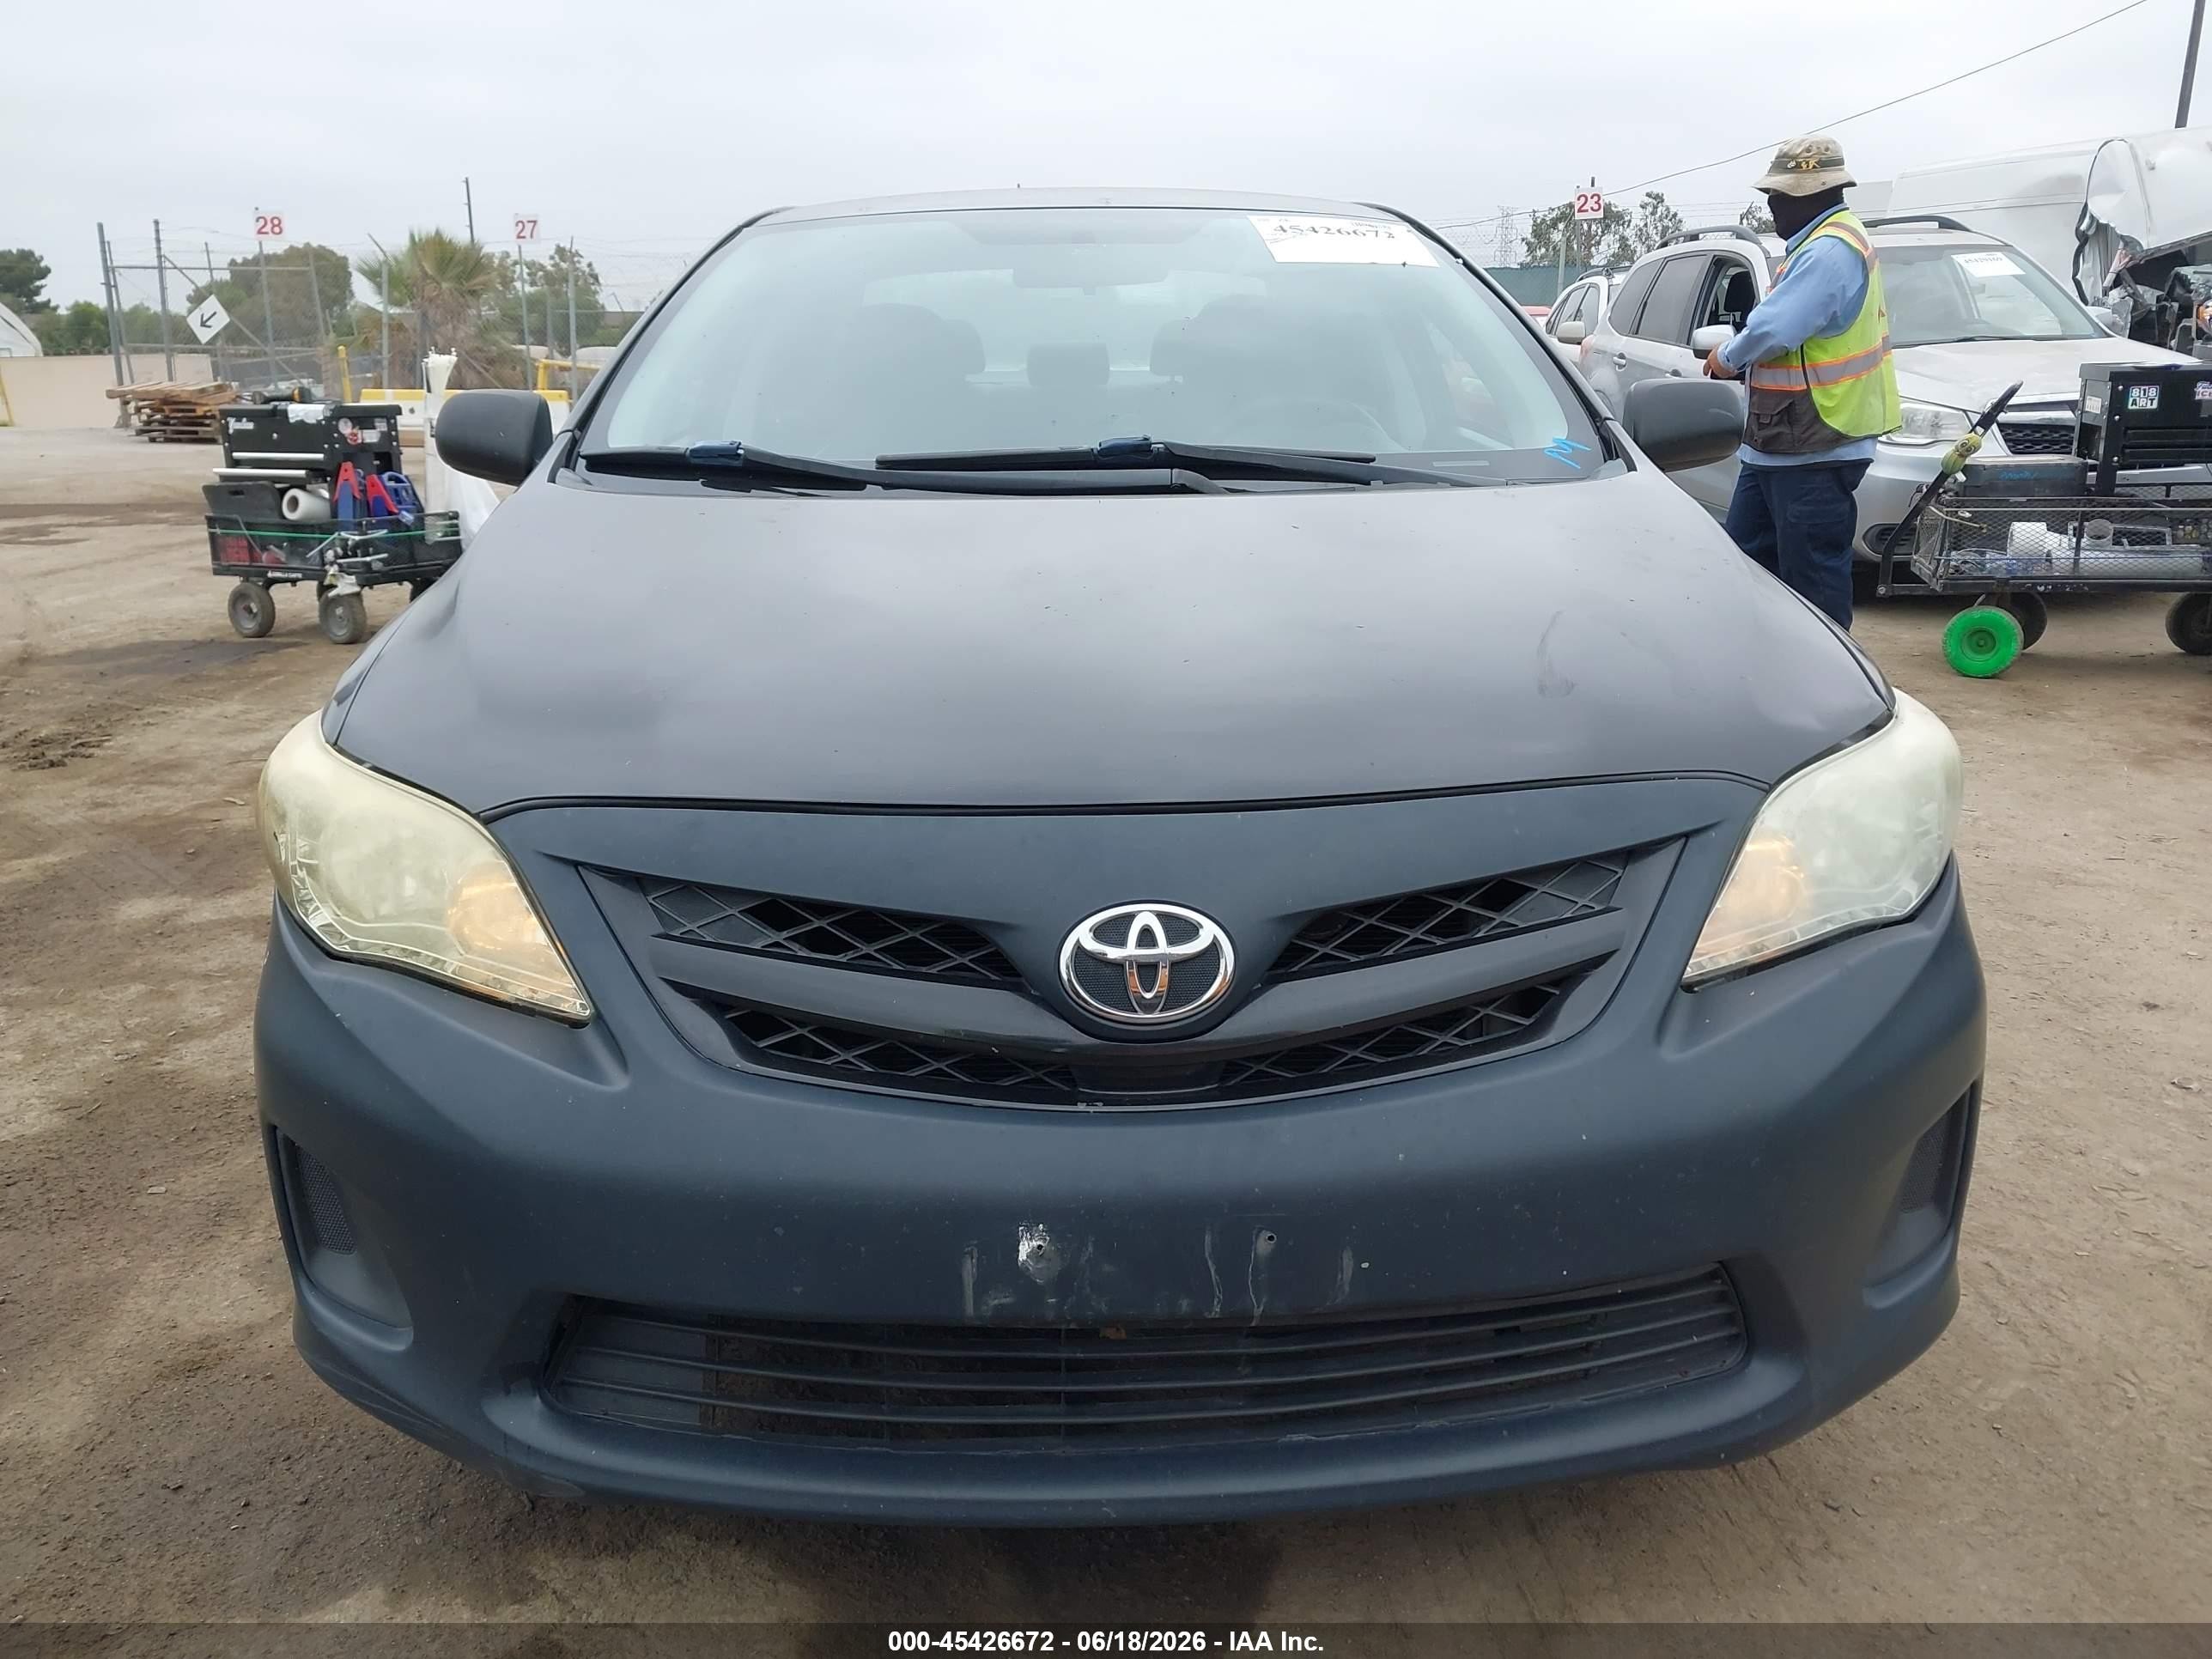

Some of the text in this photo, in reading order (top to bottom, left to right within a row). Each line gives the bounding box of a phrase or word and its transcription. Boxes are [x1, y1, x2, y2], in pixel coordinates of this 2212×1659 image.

[1577, 193, 1601, 213] 23
[256, 216, 283, 235] 28
[515, 220, 538, 239] 27
[2131, 387, 2157, 398] 818
[2130, 398, 2156, 407] ART
